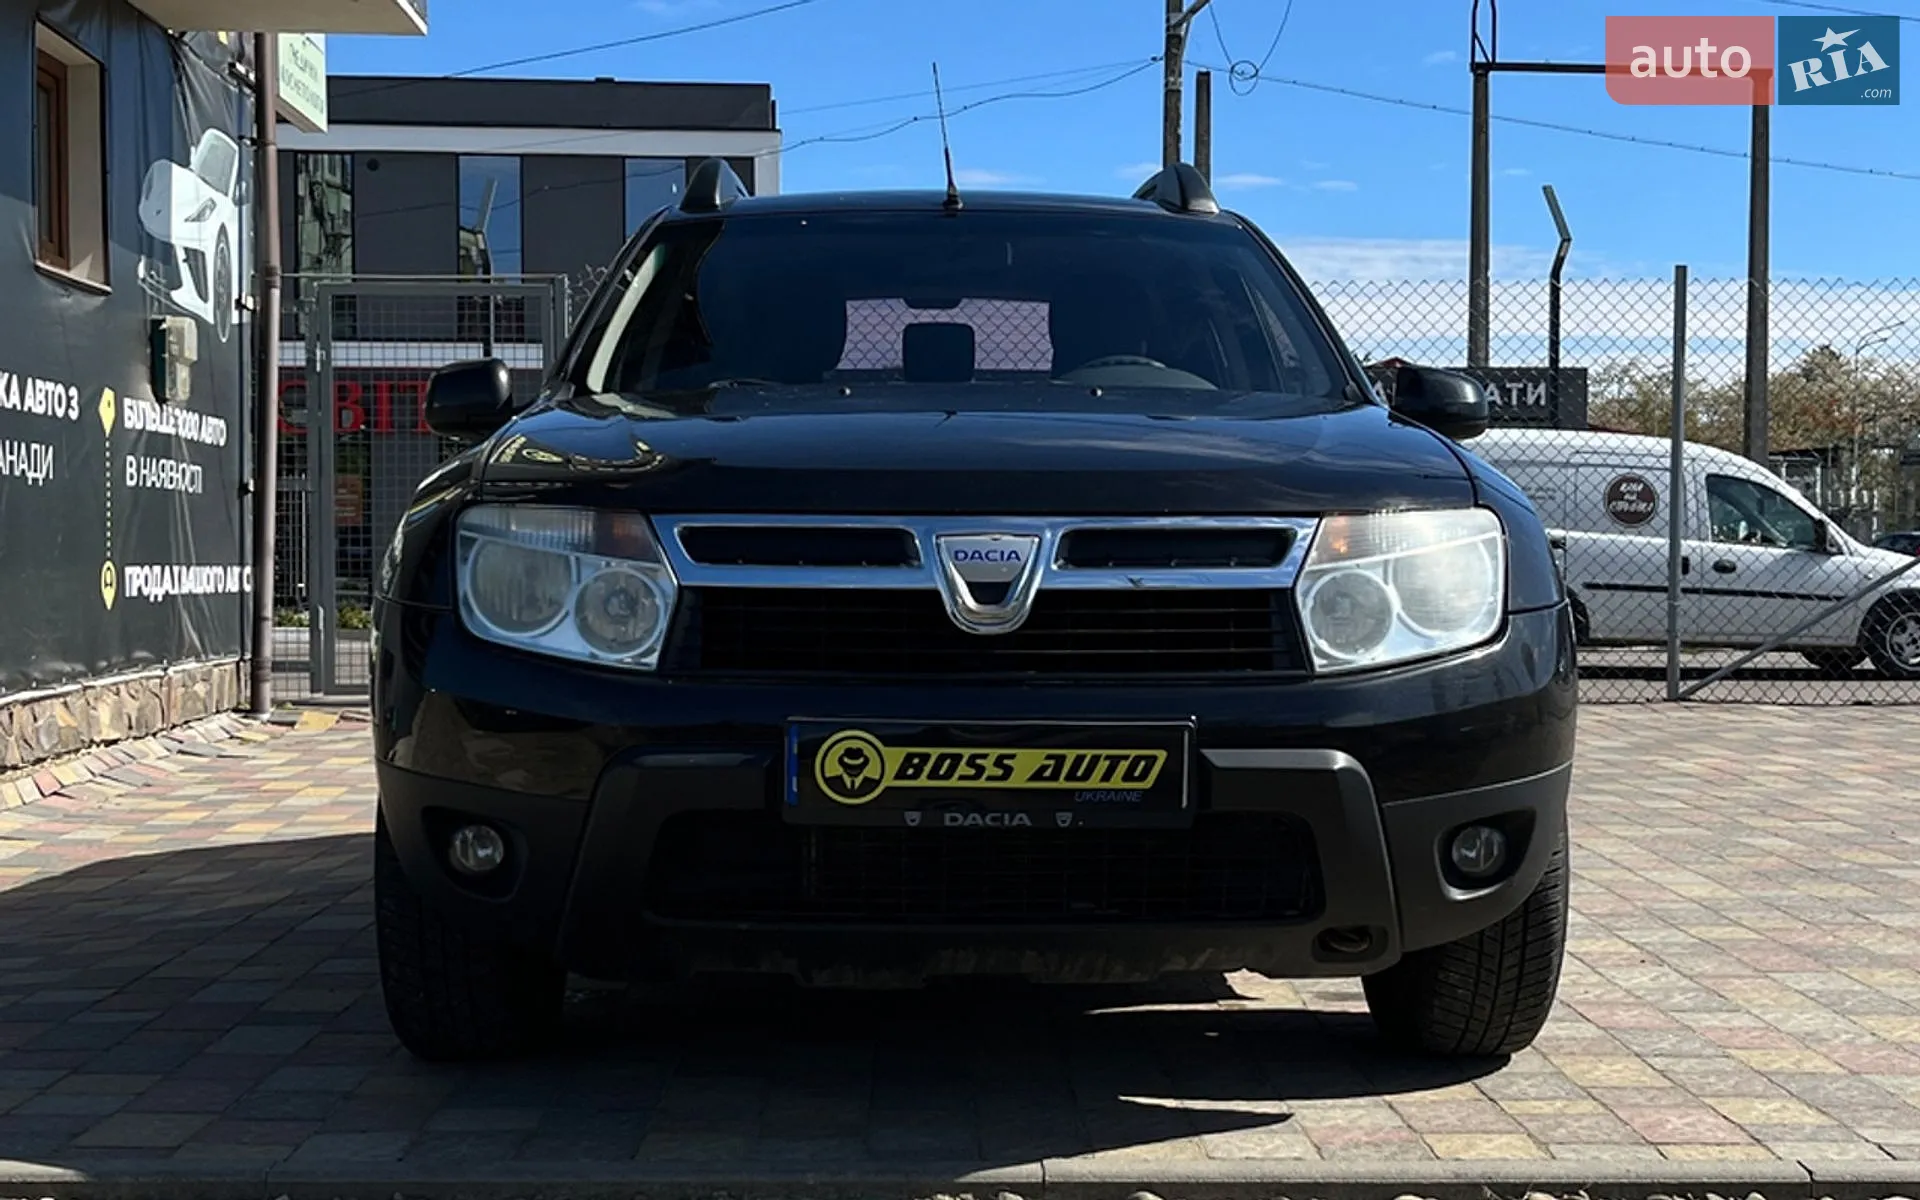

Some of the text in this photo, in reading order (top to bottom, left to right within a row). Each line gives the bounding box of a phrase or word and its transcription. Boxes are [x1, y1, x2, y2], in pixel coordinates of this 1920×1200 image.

[23, 376, 67, 419] АВТО
[125, 453, 138, 488] В
[953, 549, 1022, 562] DACIA
[893, 752, 1159, 783] BOSS AUTO
[1074, 790, 1143, 803] UKRAINE
[943, 811, 1033, 827] DACIA
